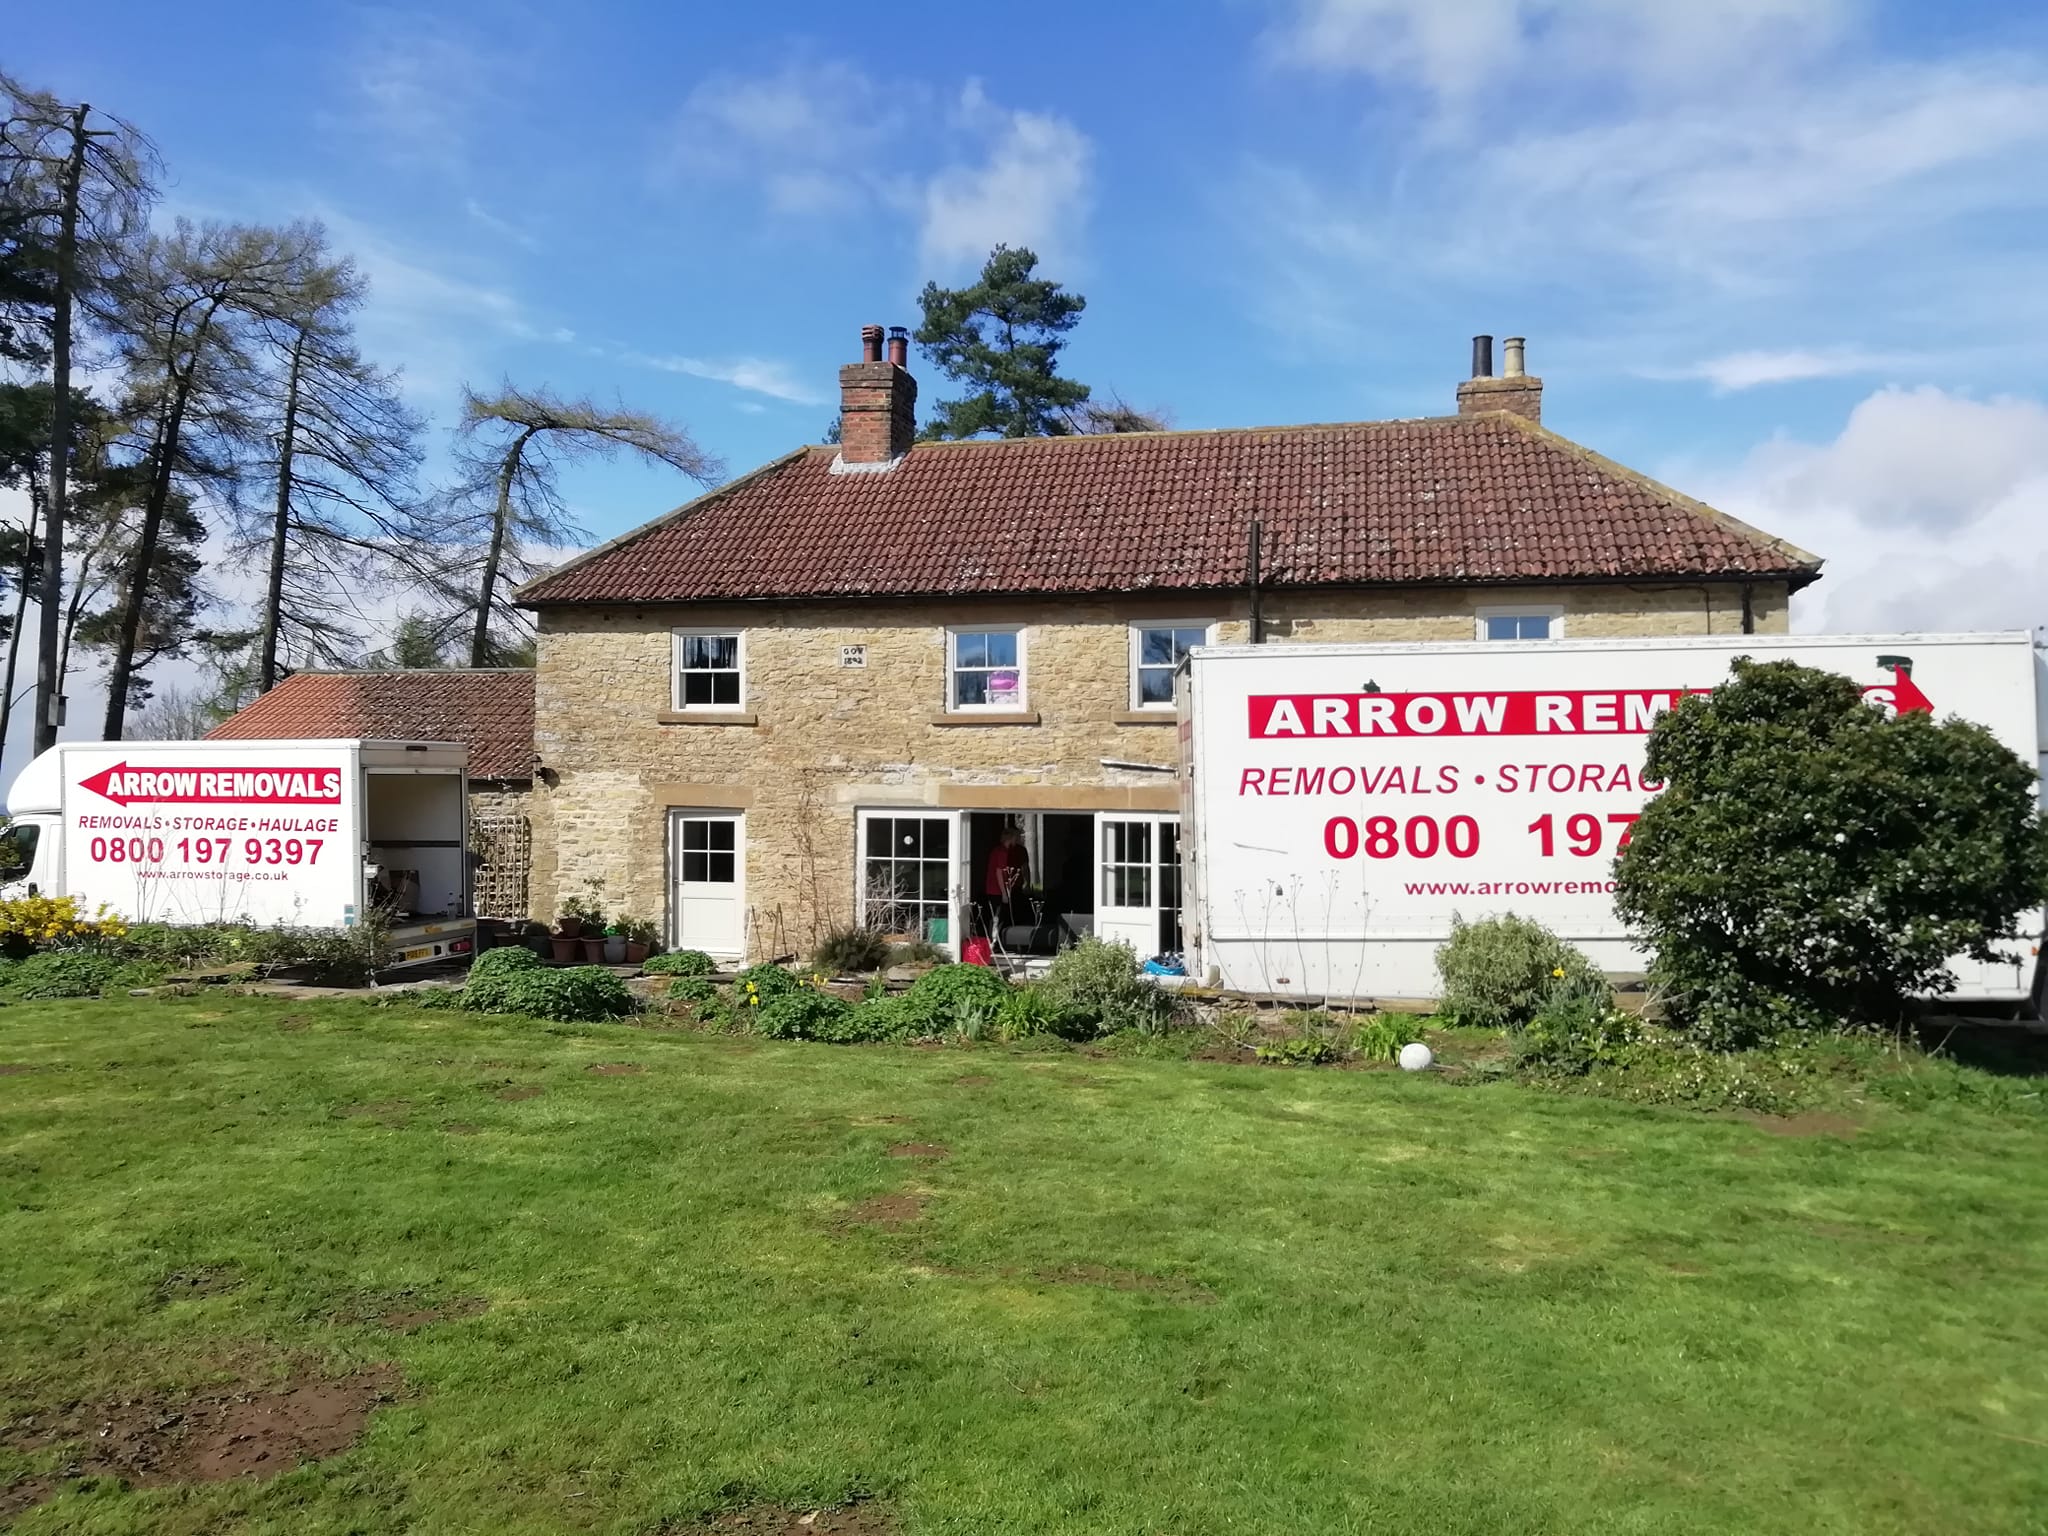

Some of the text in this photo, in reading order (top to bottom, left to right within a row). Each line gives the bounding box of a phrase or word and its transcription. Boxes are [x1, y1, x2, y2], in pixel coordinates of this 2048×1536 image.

[1265, 688, 1898, 735] ARROW REMS
[107, 772, 341, 799] ARROW REMOVALS
[1239, 763, 1665, 796] REMOVALS STORA
[78, 816, 339, 832] REMOVALS STORAGE HAULAGE
[1323, 812, 1642, 860] 0800 197
[90, 836, 324, 865] 0800 197 9397
[137, 869, 288, 882] www.arrowstorage.co.uk
[1405, 878, 1623, 896] www.arrowremo
